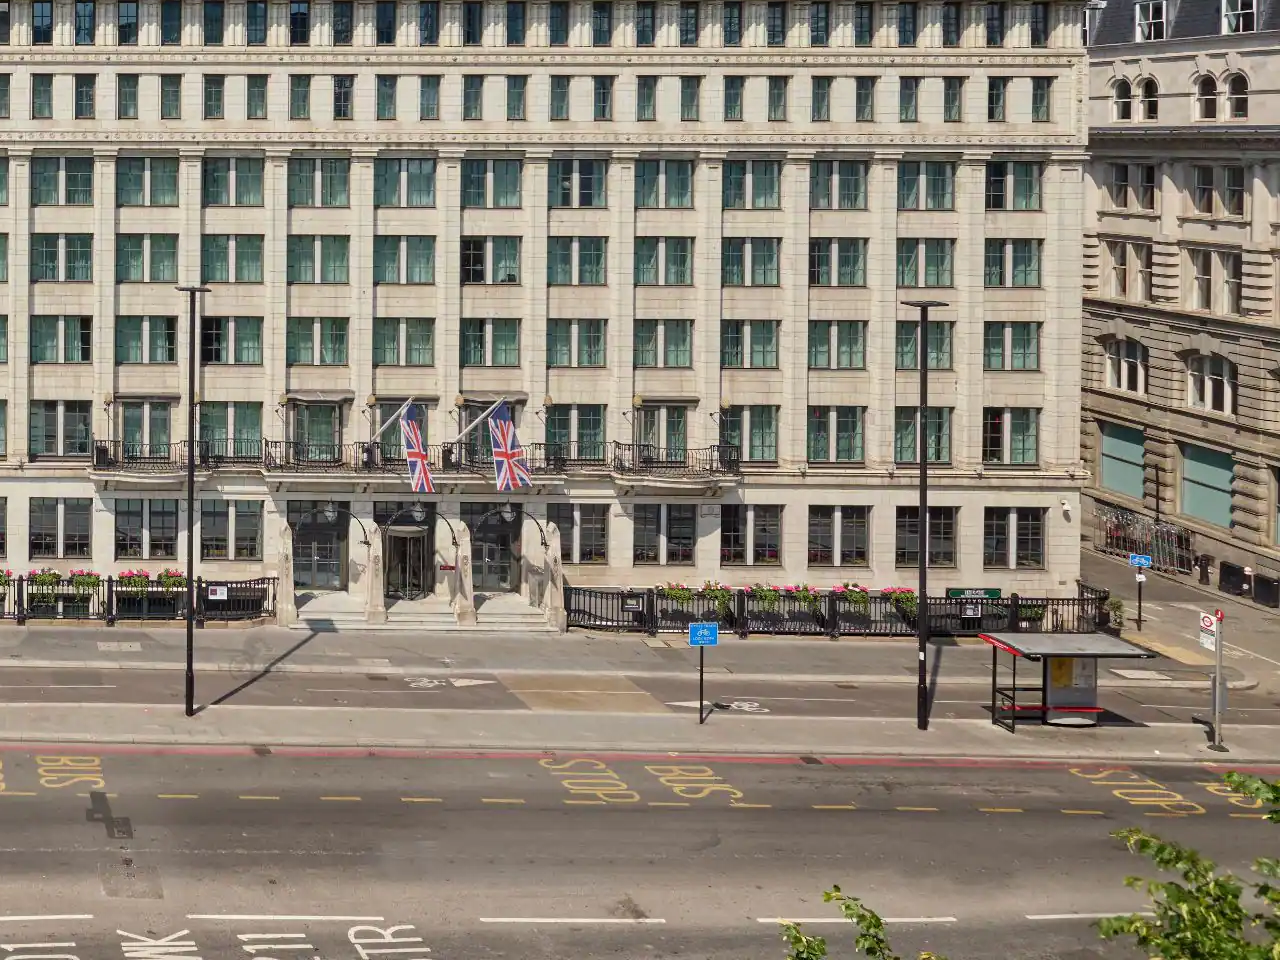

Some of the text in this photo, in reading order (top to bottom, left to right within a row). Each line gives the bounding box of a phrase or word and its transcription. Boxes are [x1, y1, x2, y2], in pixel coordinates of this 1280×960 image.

[36, 755, 106, 788] BUS
[539, 758, 640, 802] STOP
[644, 765, 744, 798] BUS
[1069, 768, 1207, 814] STOP
[1194, 781, 1264, 809] US
[347, 924, 433, 960] TR
